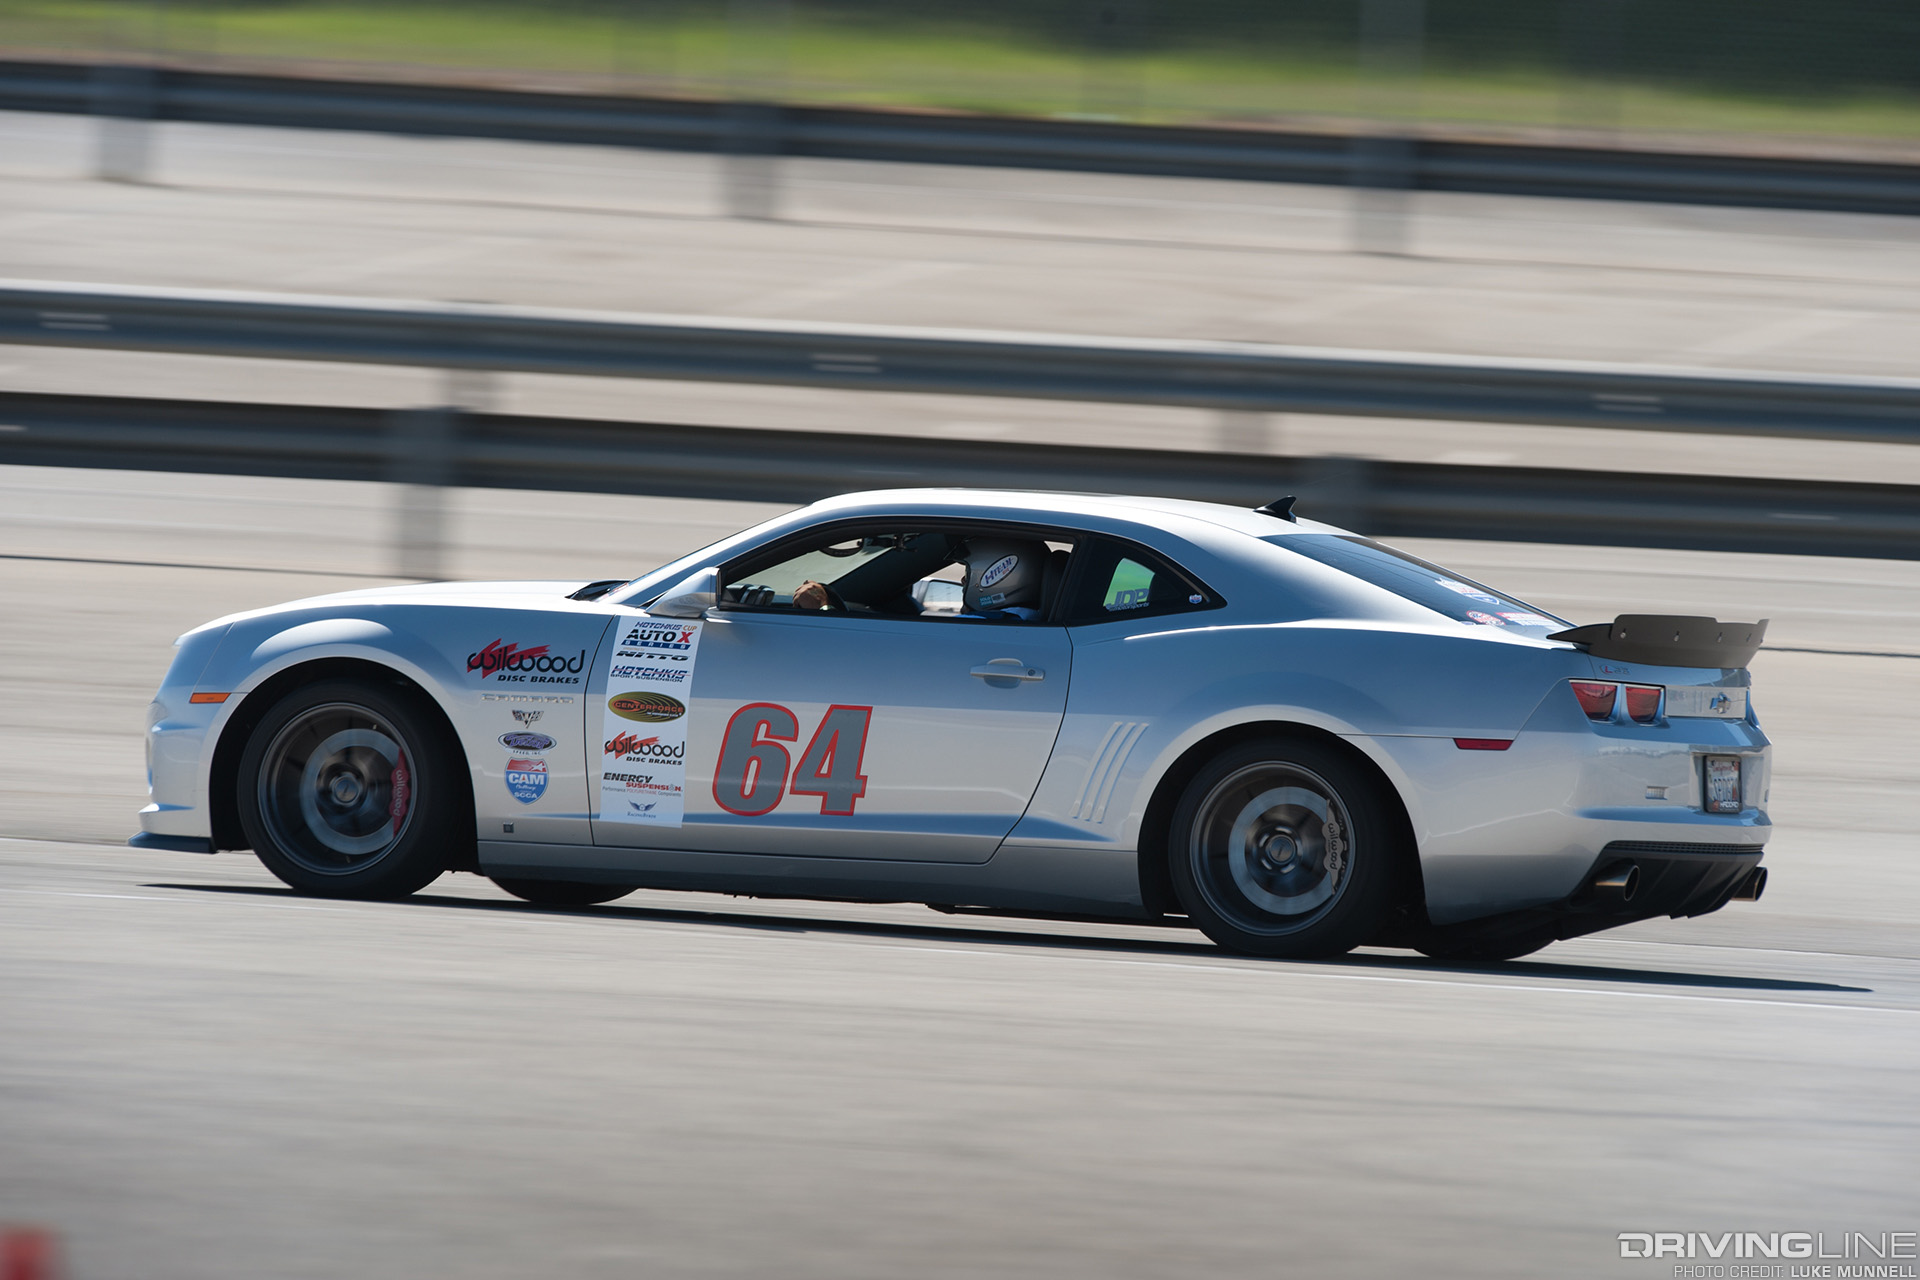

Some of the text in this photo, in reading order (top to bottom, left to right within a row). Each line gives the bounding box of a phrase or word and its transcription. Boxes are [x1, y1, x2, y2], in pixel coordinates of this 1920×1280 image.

[1106, 588, 1150, 611] JDP
[635, 621, 683, 631] HOTCHKIS
[626, 629, 694, 644] AUTO X
[624, 641, 688, 650] SERIES
[616, 651, 690, 661] NITTO
[611, 665, 688, 679] HOTCHKIS
[497, 674, 580, 684] DISC BRAKES
[635, 675, 683, 683] SUSPENSION
[481, 693, 574, 704] CAMARO
[614, 701, 684, 713] CENTERFORCE
[712, 702, 873, 817] 64
[508, 773, 545, 785] CAM
[603, 772, 653, 784] ENERGY
[514, 791, 537, 799] SCCA
[1328, 823, 1338, 870] wilwood
